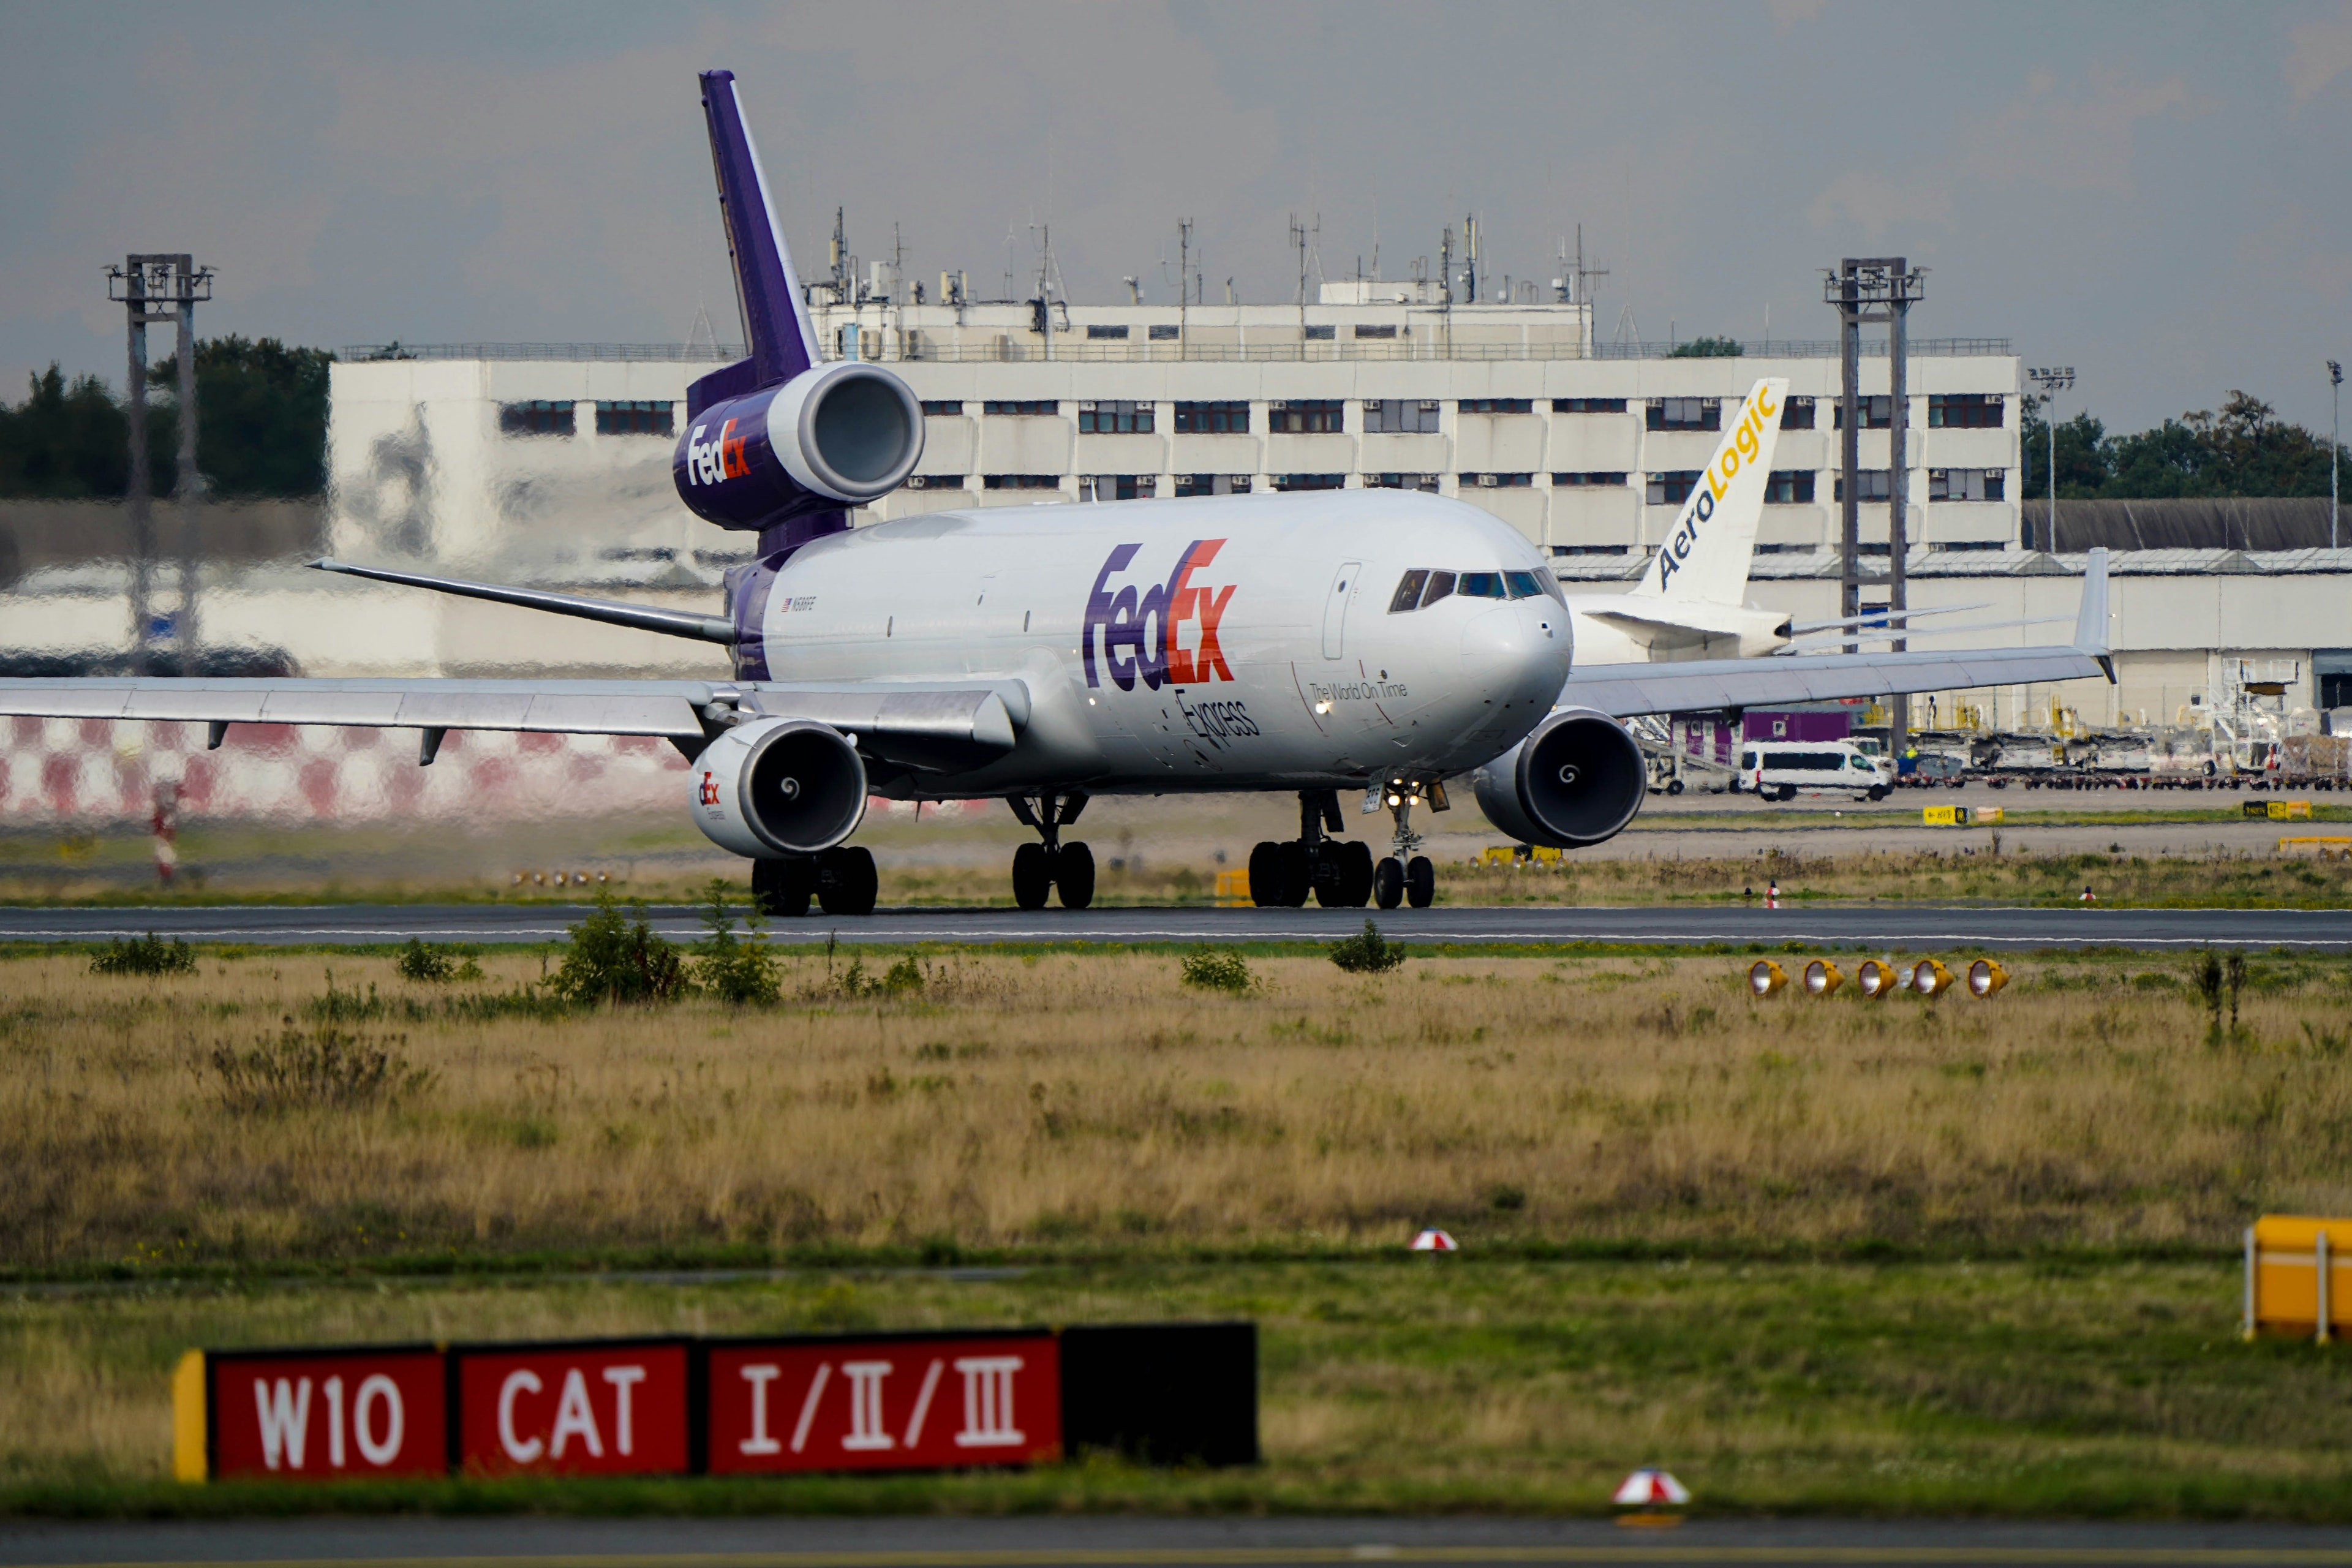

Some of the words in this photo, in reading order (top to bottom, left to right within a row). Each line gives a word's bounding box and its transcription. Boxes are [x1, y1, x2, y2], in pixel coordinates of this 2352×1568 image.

[687, 417, 752, 486] FedEx
[1659, 386, 1776, 594] AeroLogic
[1082, 538, 1238, 692] FedEx
[1174, 688, 1261, 748] Express
[1309, 683, 1330, 700] The
[1328, 682, 1361, 700] World
[1360, 682, 1379, 699] On
[1377, 681, 1408, 698] Time
[699, 771, 721, 807] dEx
[255, 1378, 404, 1469] W10
[498, 1366, 646, 1463] CAT
[739, 1355, 1025, 1455] I/II/III
